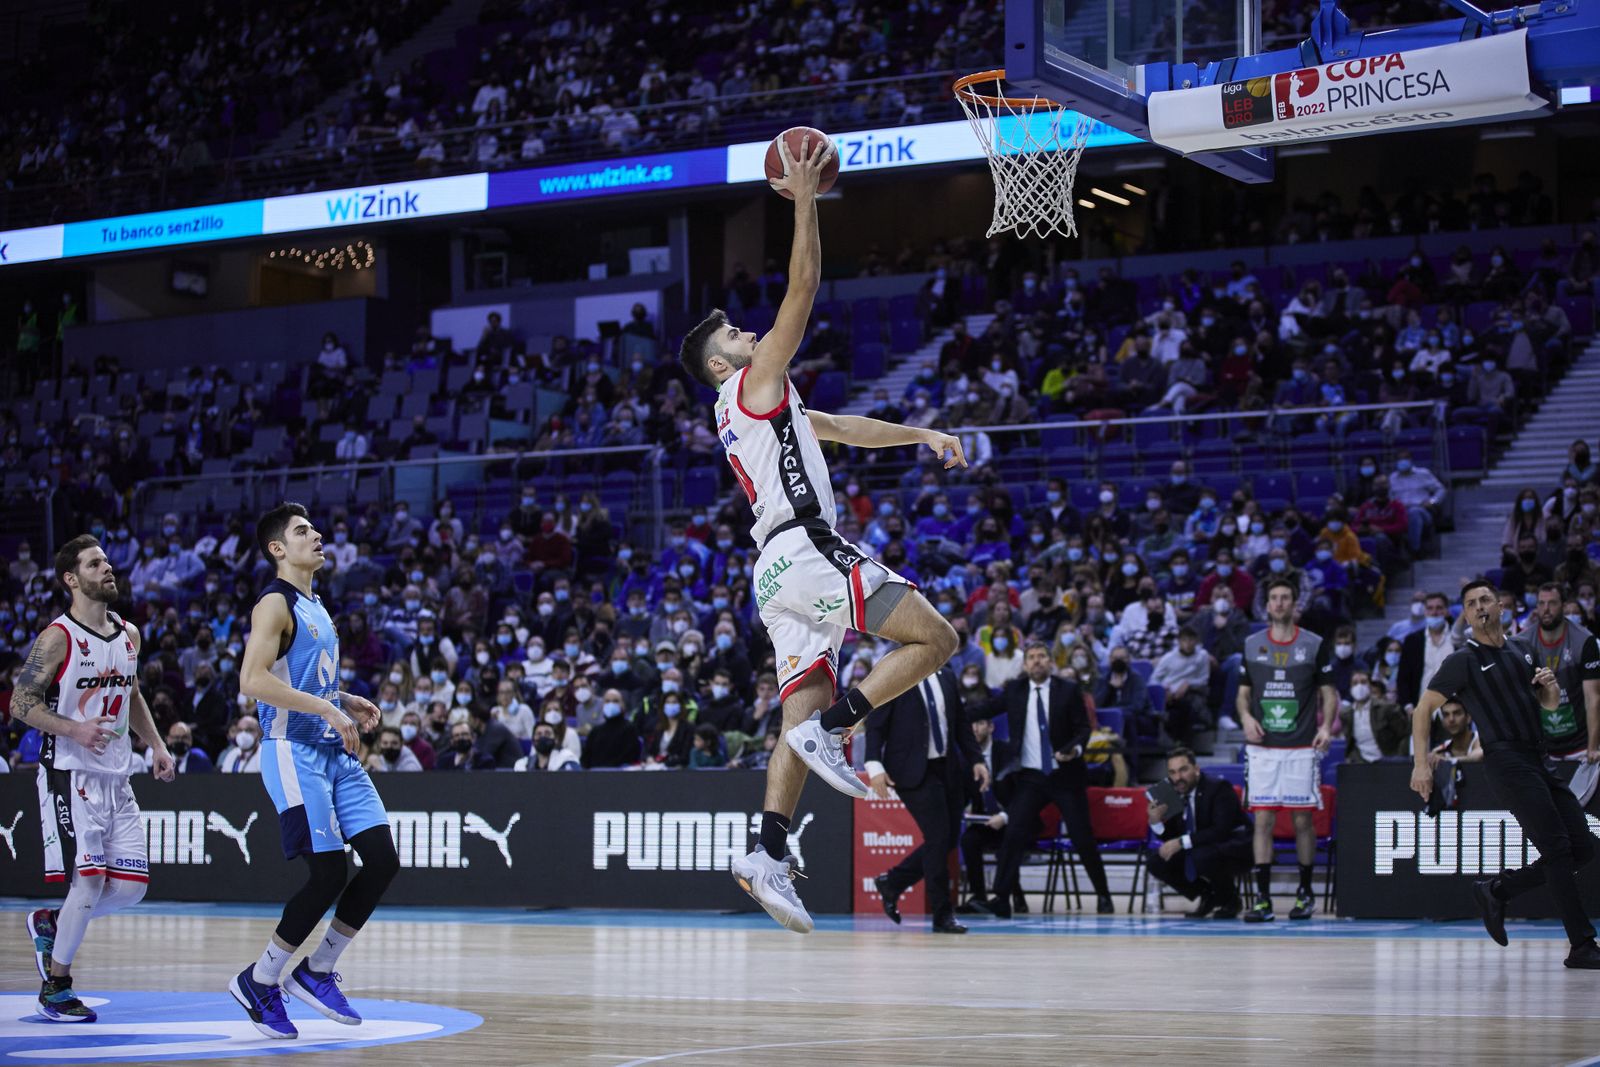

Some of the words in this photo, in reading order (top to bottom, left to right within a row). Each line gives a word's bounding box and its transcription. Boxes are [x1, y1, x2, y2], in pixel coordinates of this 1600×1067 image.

[1326, 53, 1405, 82] COPA
[1223, 83, 1242, 95] Liga
[1327, 69, 1451, 112] PRINCESA
[1225, 97, 1254, 113] LEB
[1278, 101, 1286, 119] FEB
[1296, 102, 1326, 117] 2022
[1226, 111, 1253, 125] ORO
[539, 163, 673, 195] www.wizink.es
[326, 190, 420, 222] WiZink
[101, 228, 117, 243] Tu
[121, 225, 164, 241] banco
[101, 694, 123, 720] 14
[592, 811, 748, 870] PUMA
[862, 832, 914, 847] Mahou
